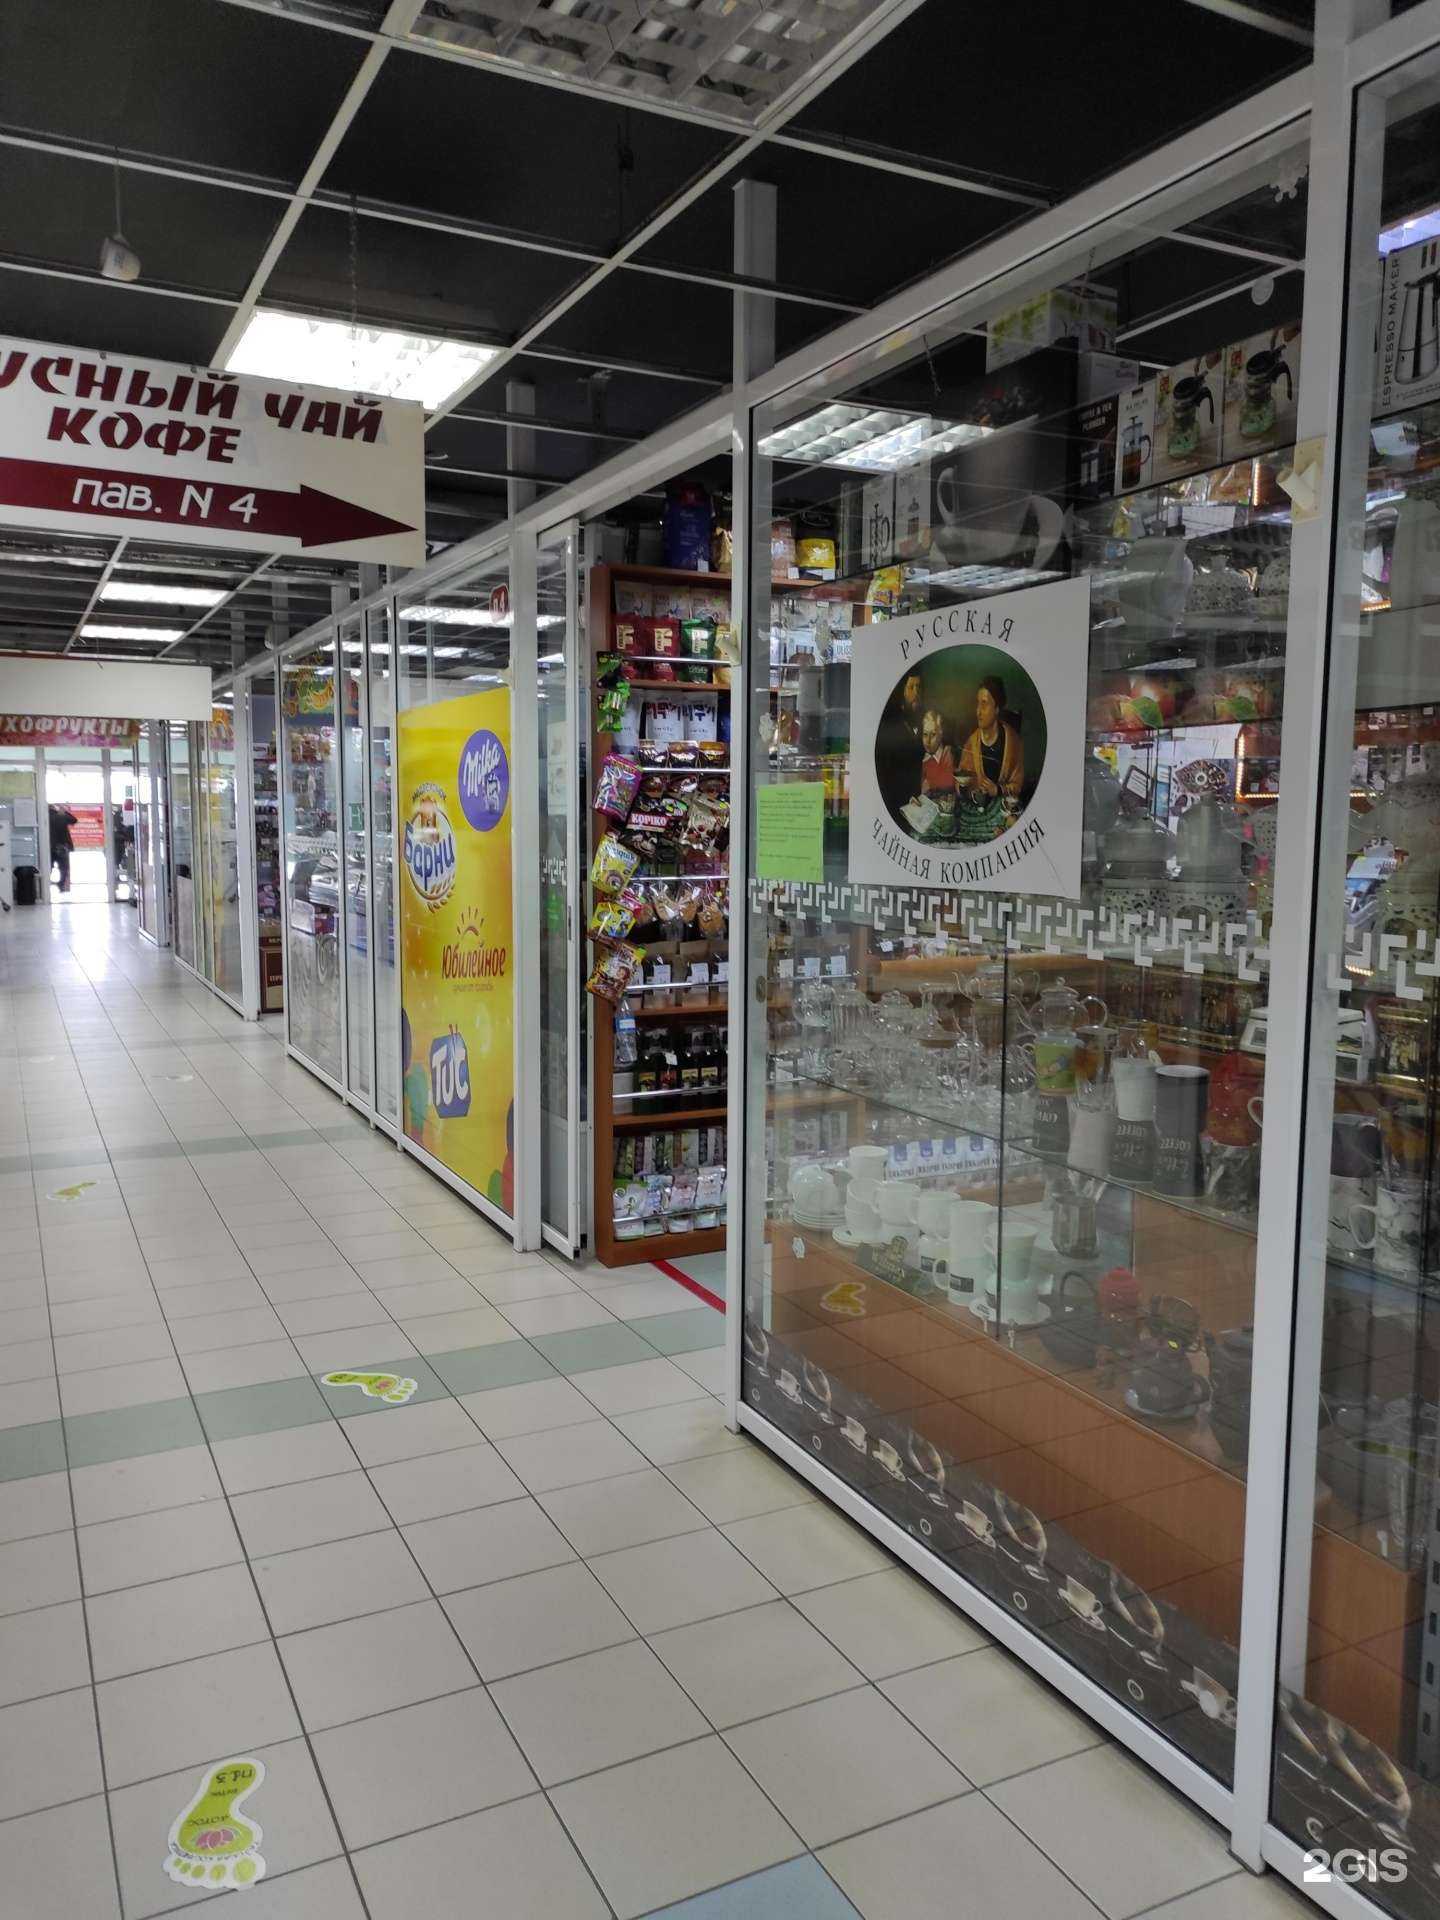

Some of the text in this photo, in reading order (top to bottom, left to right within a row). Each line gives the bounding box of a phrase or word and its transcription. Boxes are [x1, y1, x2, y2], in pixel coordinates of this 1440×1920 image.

[1382, 258, 1401, 407] ESPRESSO MAKER
[46, 405, 241, 464] КОФЕ
[264, 391, 383, 444] ЧАЙ
[72, 478, 259, 524] пав. N 4
[899, 609, 1016, 661] РУССКАЯ
[0, 715, 130, 737] ХОФРУКТЫ
[463, 737, 501, 798] Milka
[631, 813, 668, 827] KOPIKO
[871, 817, 932, 881] ЧАЙНАЯ
[940, 816, 1046, 884] КОМПАНИЯ
[442, 941, 506, 979] Юбилейное
[431, 1043, 469, 1107] TUC
